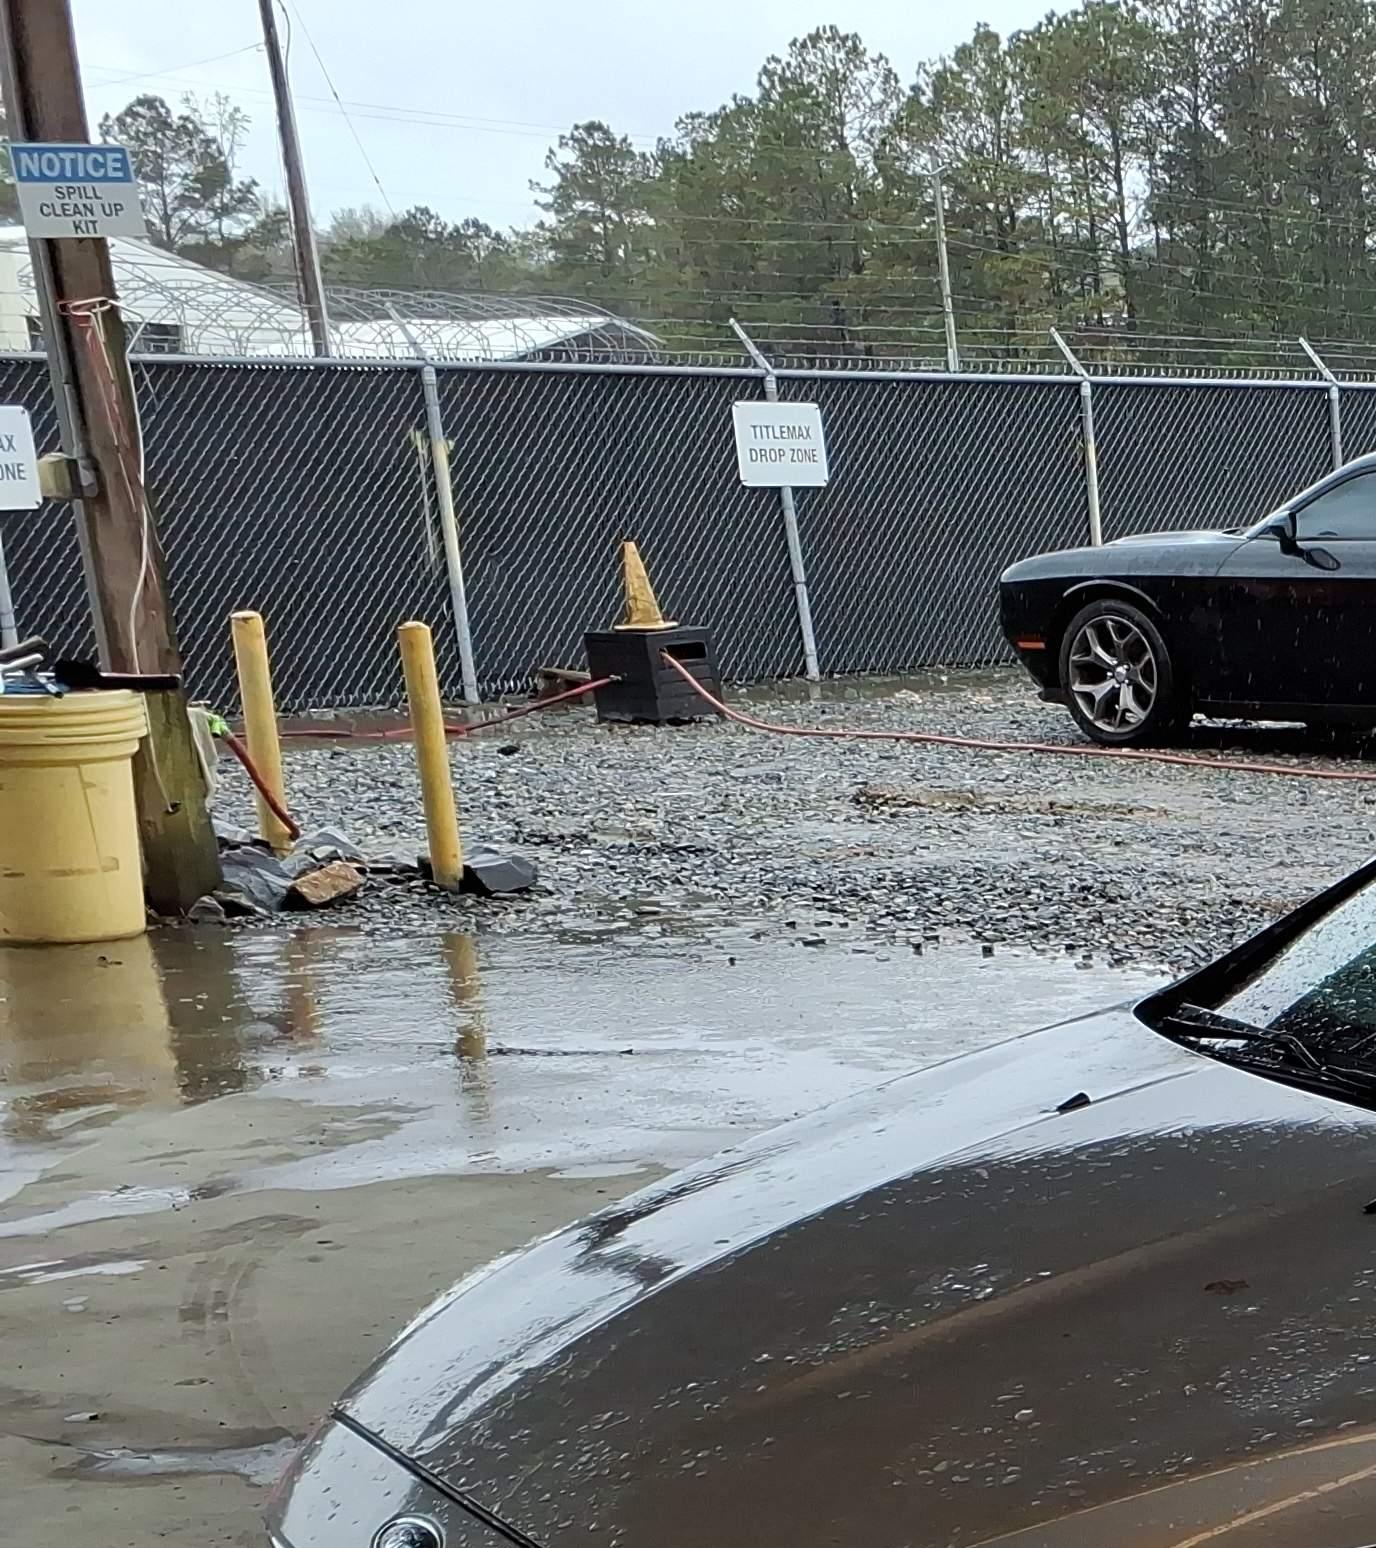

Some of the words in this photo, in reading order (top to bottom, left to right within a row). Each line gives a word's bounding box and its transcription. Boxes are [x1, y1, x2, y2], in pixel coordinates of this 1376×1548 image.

[20, 152, 125, 178] NOTICE
[54, 185, 103, 200] SPILL
[40, 202, 95, 217] CLEAN
[101, 203, 125, 217] UP
[72, 220, 99, 234] KIT
[750, 424, 812, 440] TITLEMAX
[749, 448, 786, 463] DROP
[790, 448, 818, 463] ZONE
